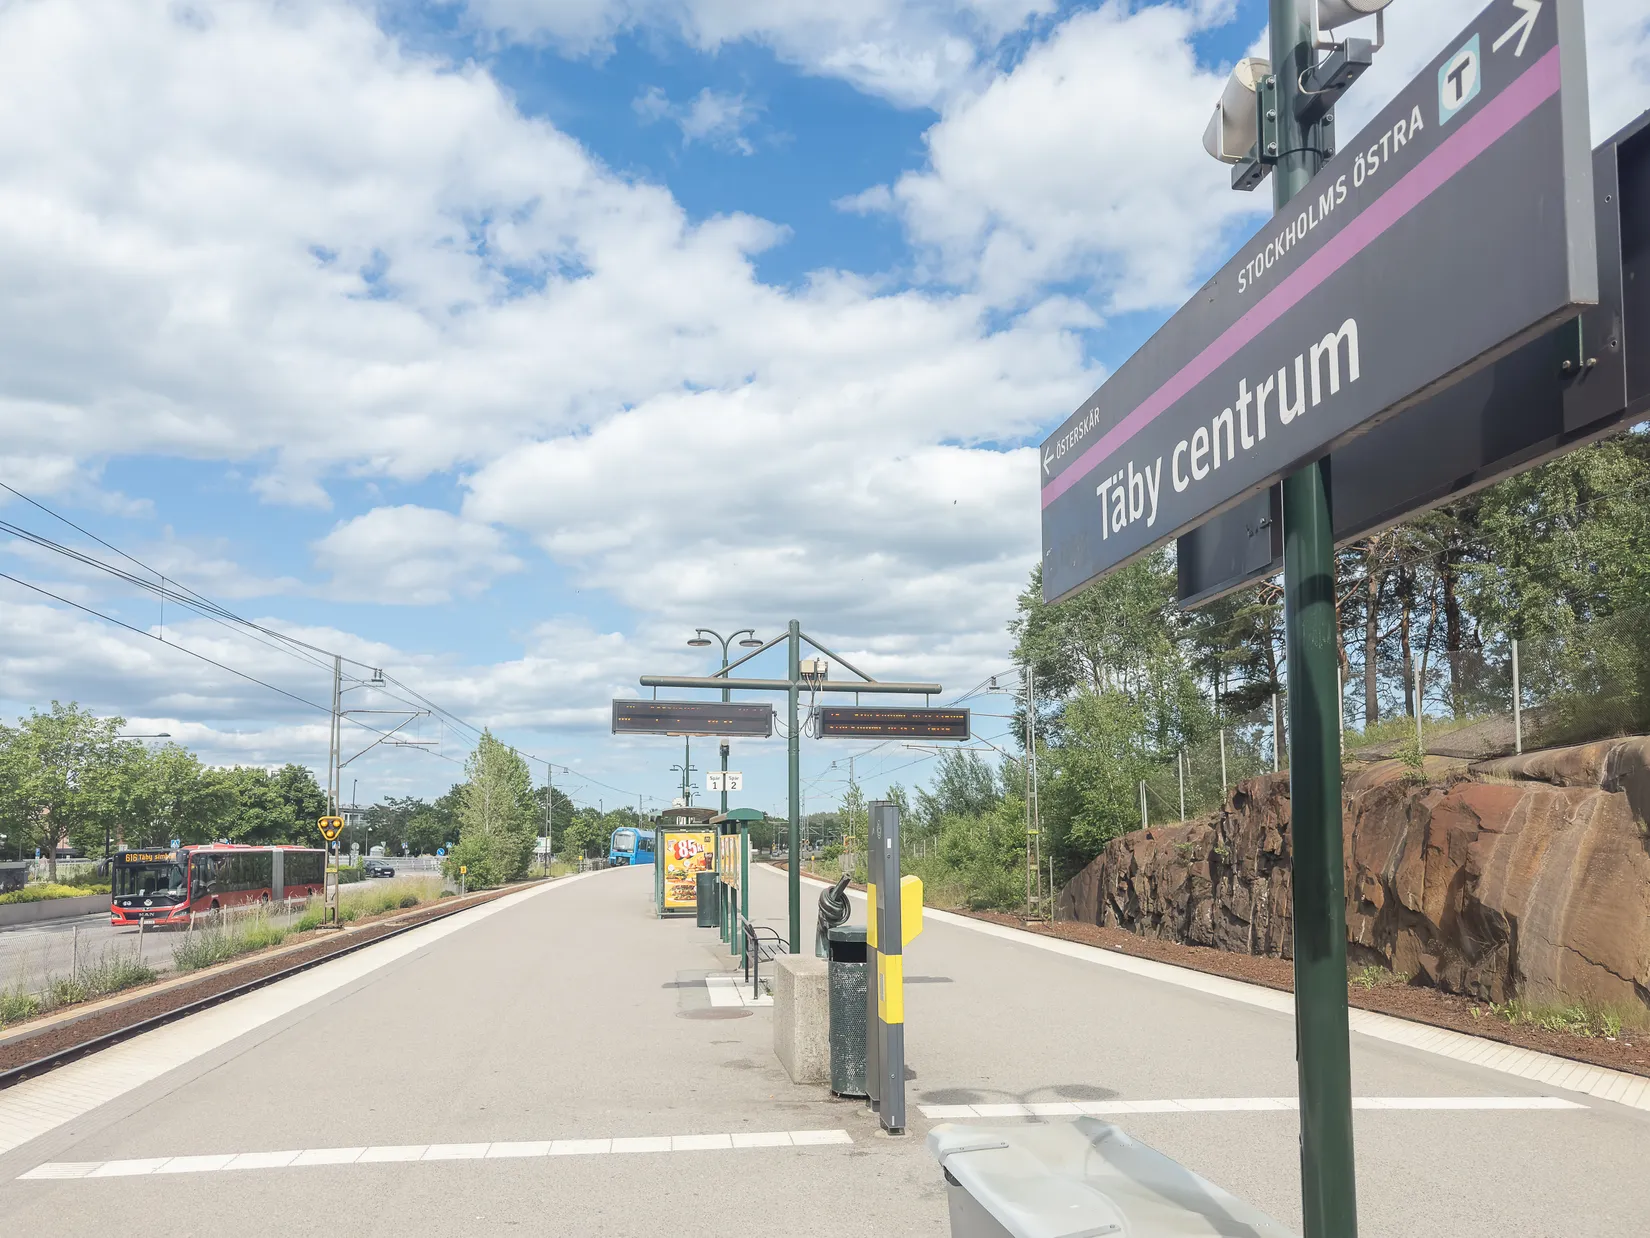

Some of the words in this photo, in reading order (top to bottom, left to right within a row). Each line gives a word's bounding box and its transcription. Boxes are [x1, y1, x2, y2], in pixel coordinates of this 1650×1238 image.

[1238, 174, 1347, 294] STOCKHOLMS
[1353, 105, 1424, 188] ÖSTRA
[1447, 56, 1470, 102] T
[1056, 407, 1100, 460] ÖSTERSKÄR
[1096, 456, 1162, 541] Täby
[1172, 318, 1360, 493] centrum
[712, 782, 718, 790] 1
[731, 782, 736, 790] 2
[125, 853, 138, 862] 616
[676, 839, 698, 858] 85
